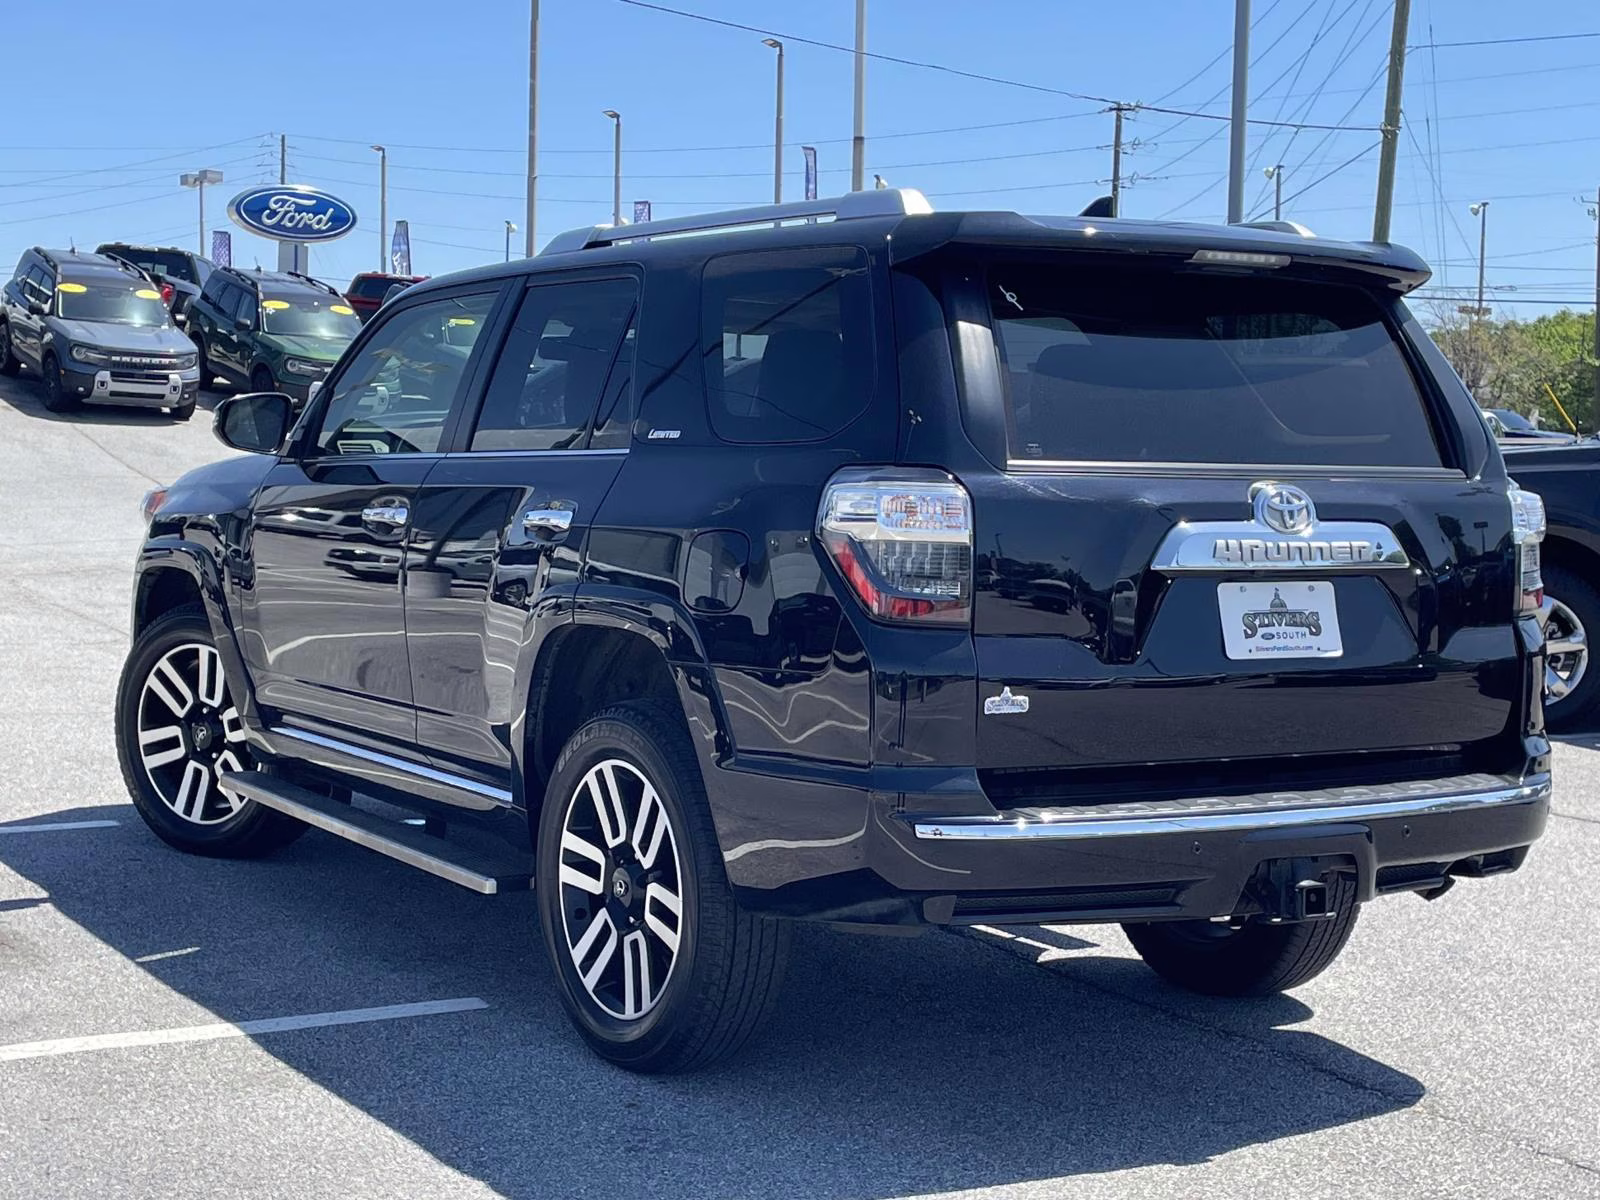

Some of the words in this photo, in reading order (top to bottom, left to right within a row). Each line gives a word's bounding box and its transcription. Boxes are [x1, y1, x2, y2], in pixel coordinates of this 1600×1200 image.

[261, 195, 335, 230] Ford
[1242, 611, 1322, 639] STIVERS
[1276, 631, 1307, 640] SOUTH
